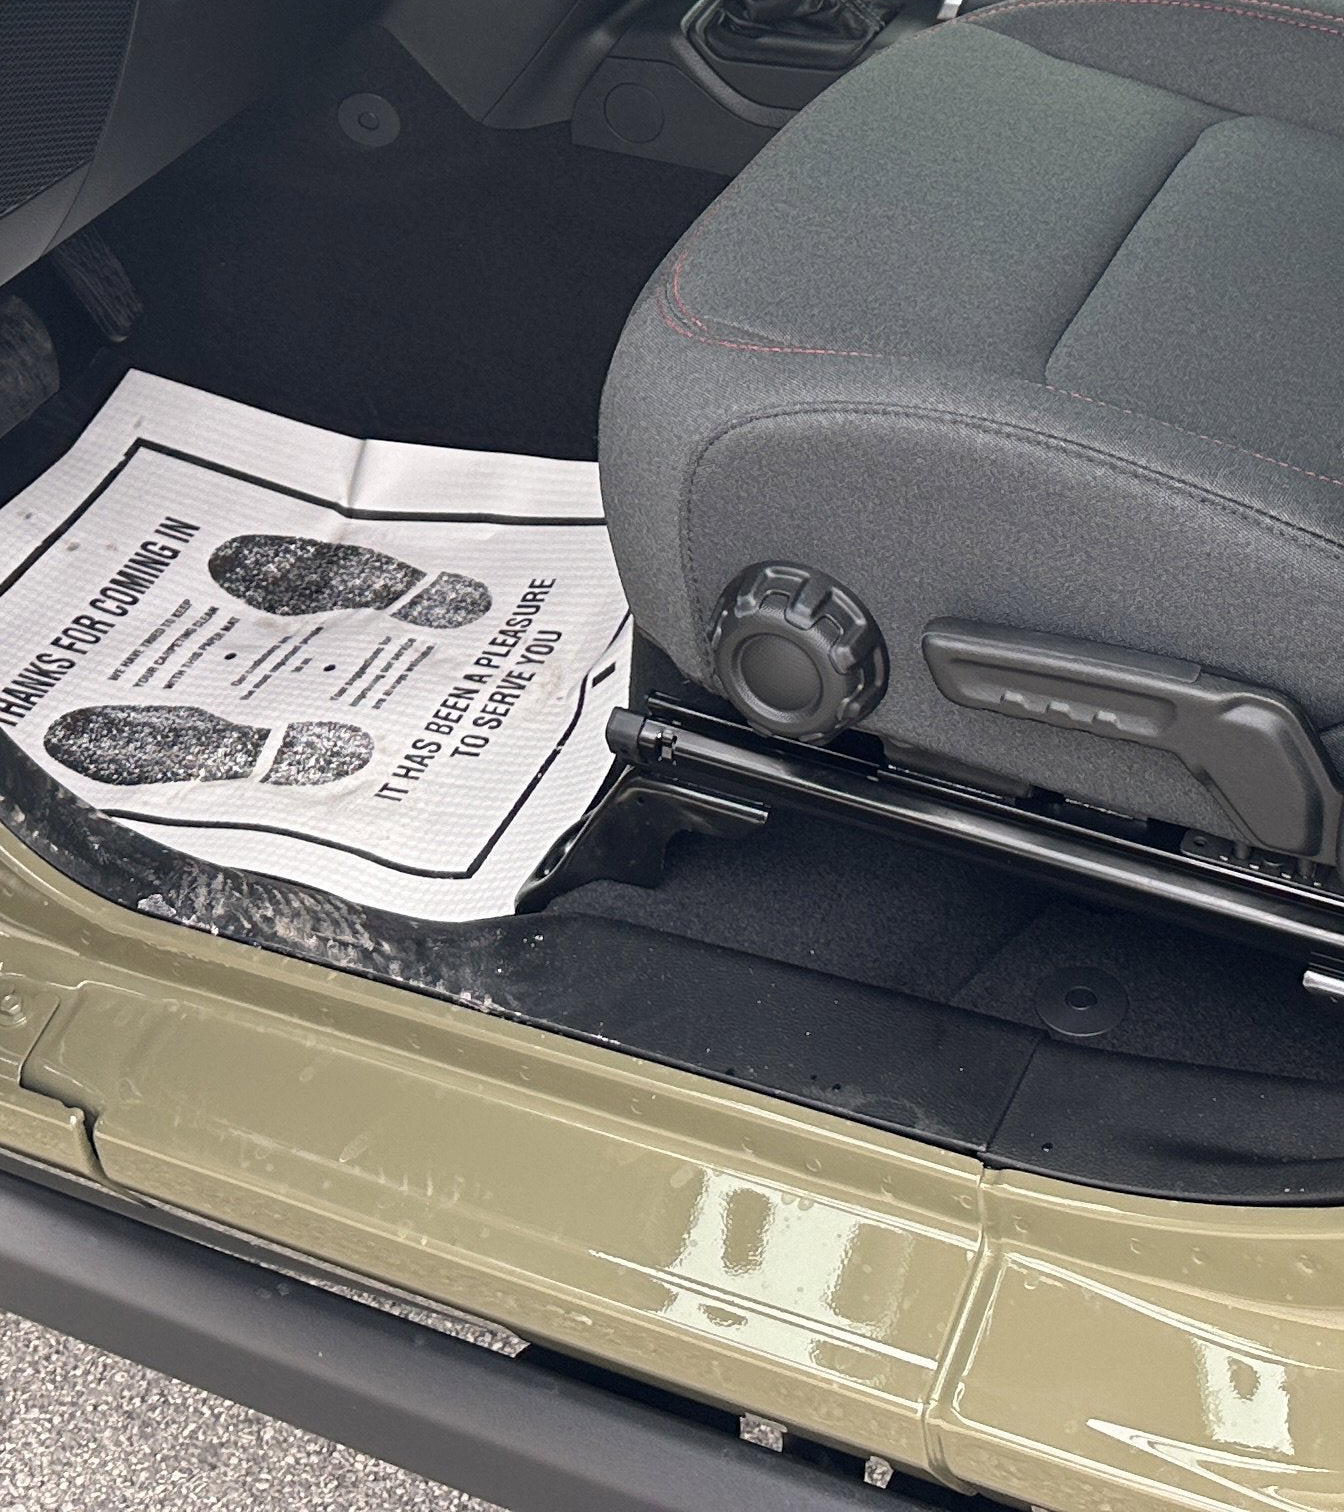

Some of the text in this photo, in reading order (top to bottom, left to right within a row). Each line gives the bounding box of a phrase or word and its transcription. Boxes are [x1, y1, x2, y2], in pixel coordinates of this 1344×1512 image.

[50, 614, 116, 655] FOR
[89, 540, 182, 617] COMING
[154, 516, 201, 543] IN
[108, 668, 126, 681] WE
[120, 649, 145, 669] HAVE
[138, 627, 166, 648] TRIED
[160, 618, 176, 629] TO
[132, 605, 220, 688] YOUR CARPETING CLEAN
[163, 616, 240, 689] WITH THIS PAPER MAT
[374, 578, 556, 802] IT HAS BEEN A PLEASURE
[449, 629, 563, 758] TO SERVE YOU
